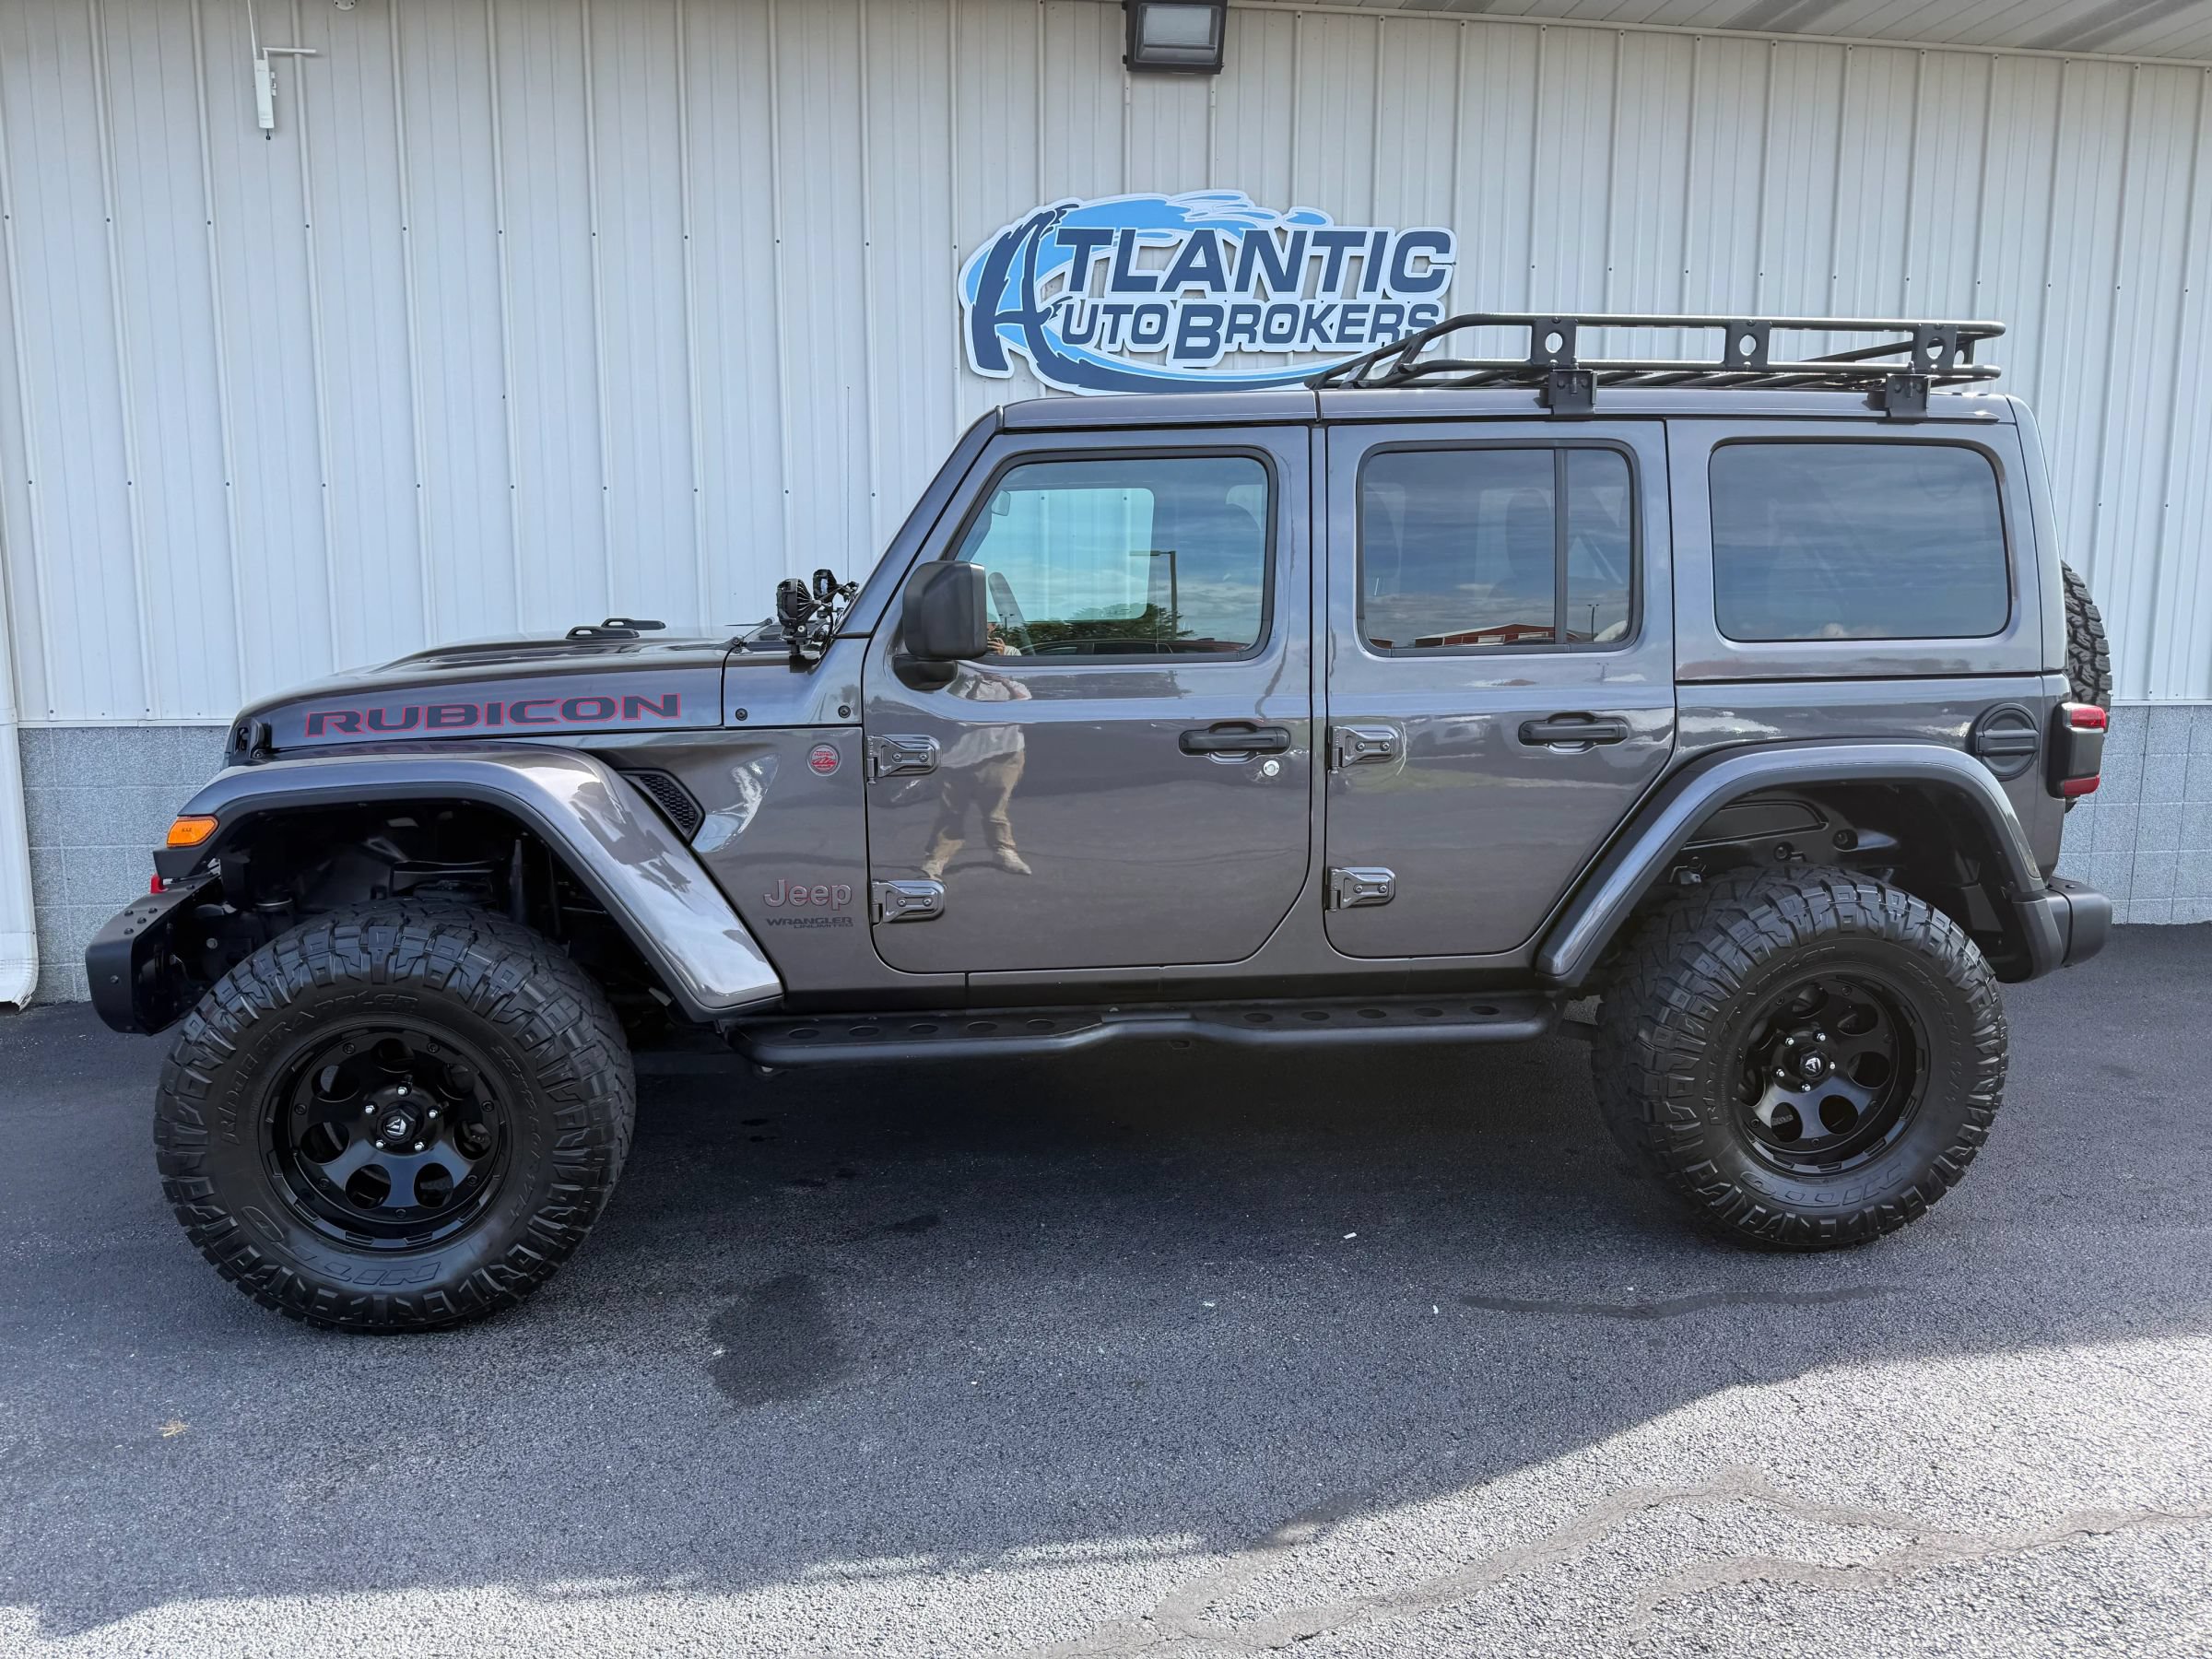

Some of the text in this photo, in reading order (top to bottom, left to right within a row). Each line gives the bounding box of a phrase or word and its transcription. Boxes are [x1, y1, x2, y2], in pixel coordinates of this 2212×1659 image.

[974, 204, 1451, 371] ATLANTIC
[1172, 302, 1440, 360] BROKERS
[304, 693, 681, 737] RUBICON
[763, 878, 853, 912] Jeep
[766, 916, 853, 927] WRANGLER
